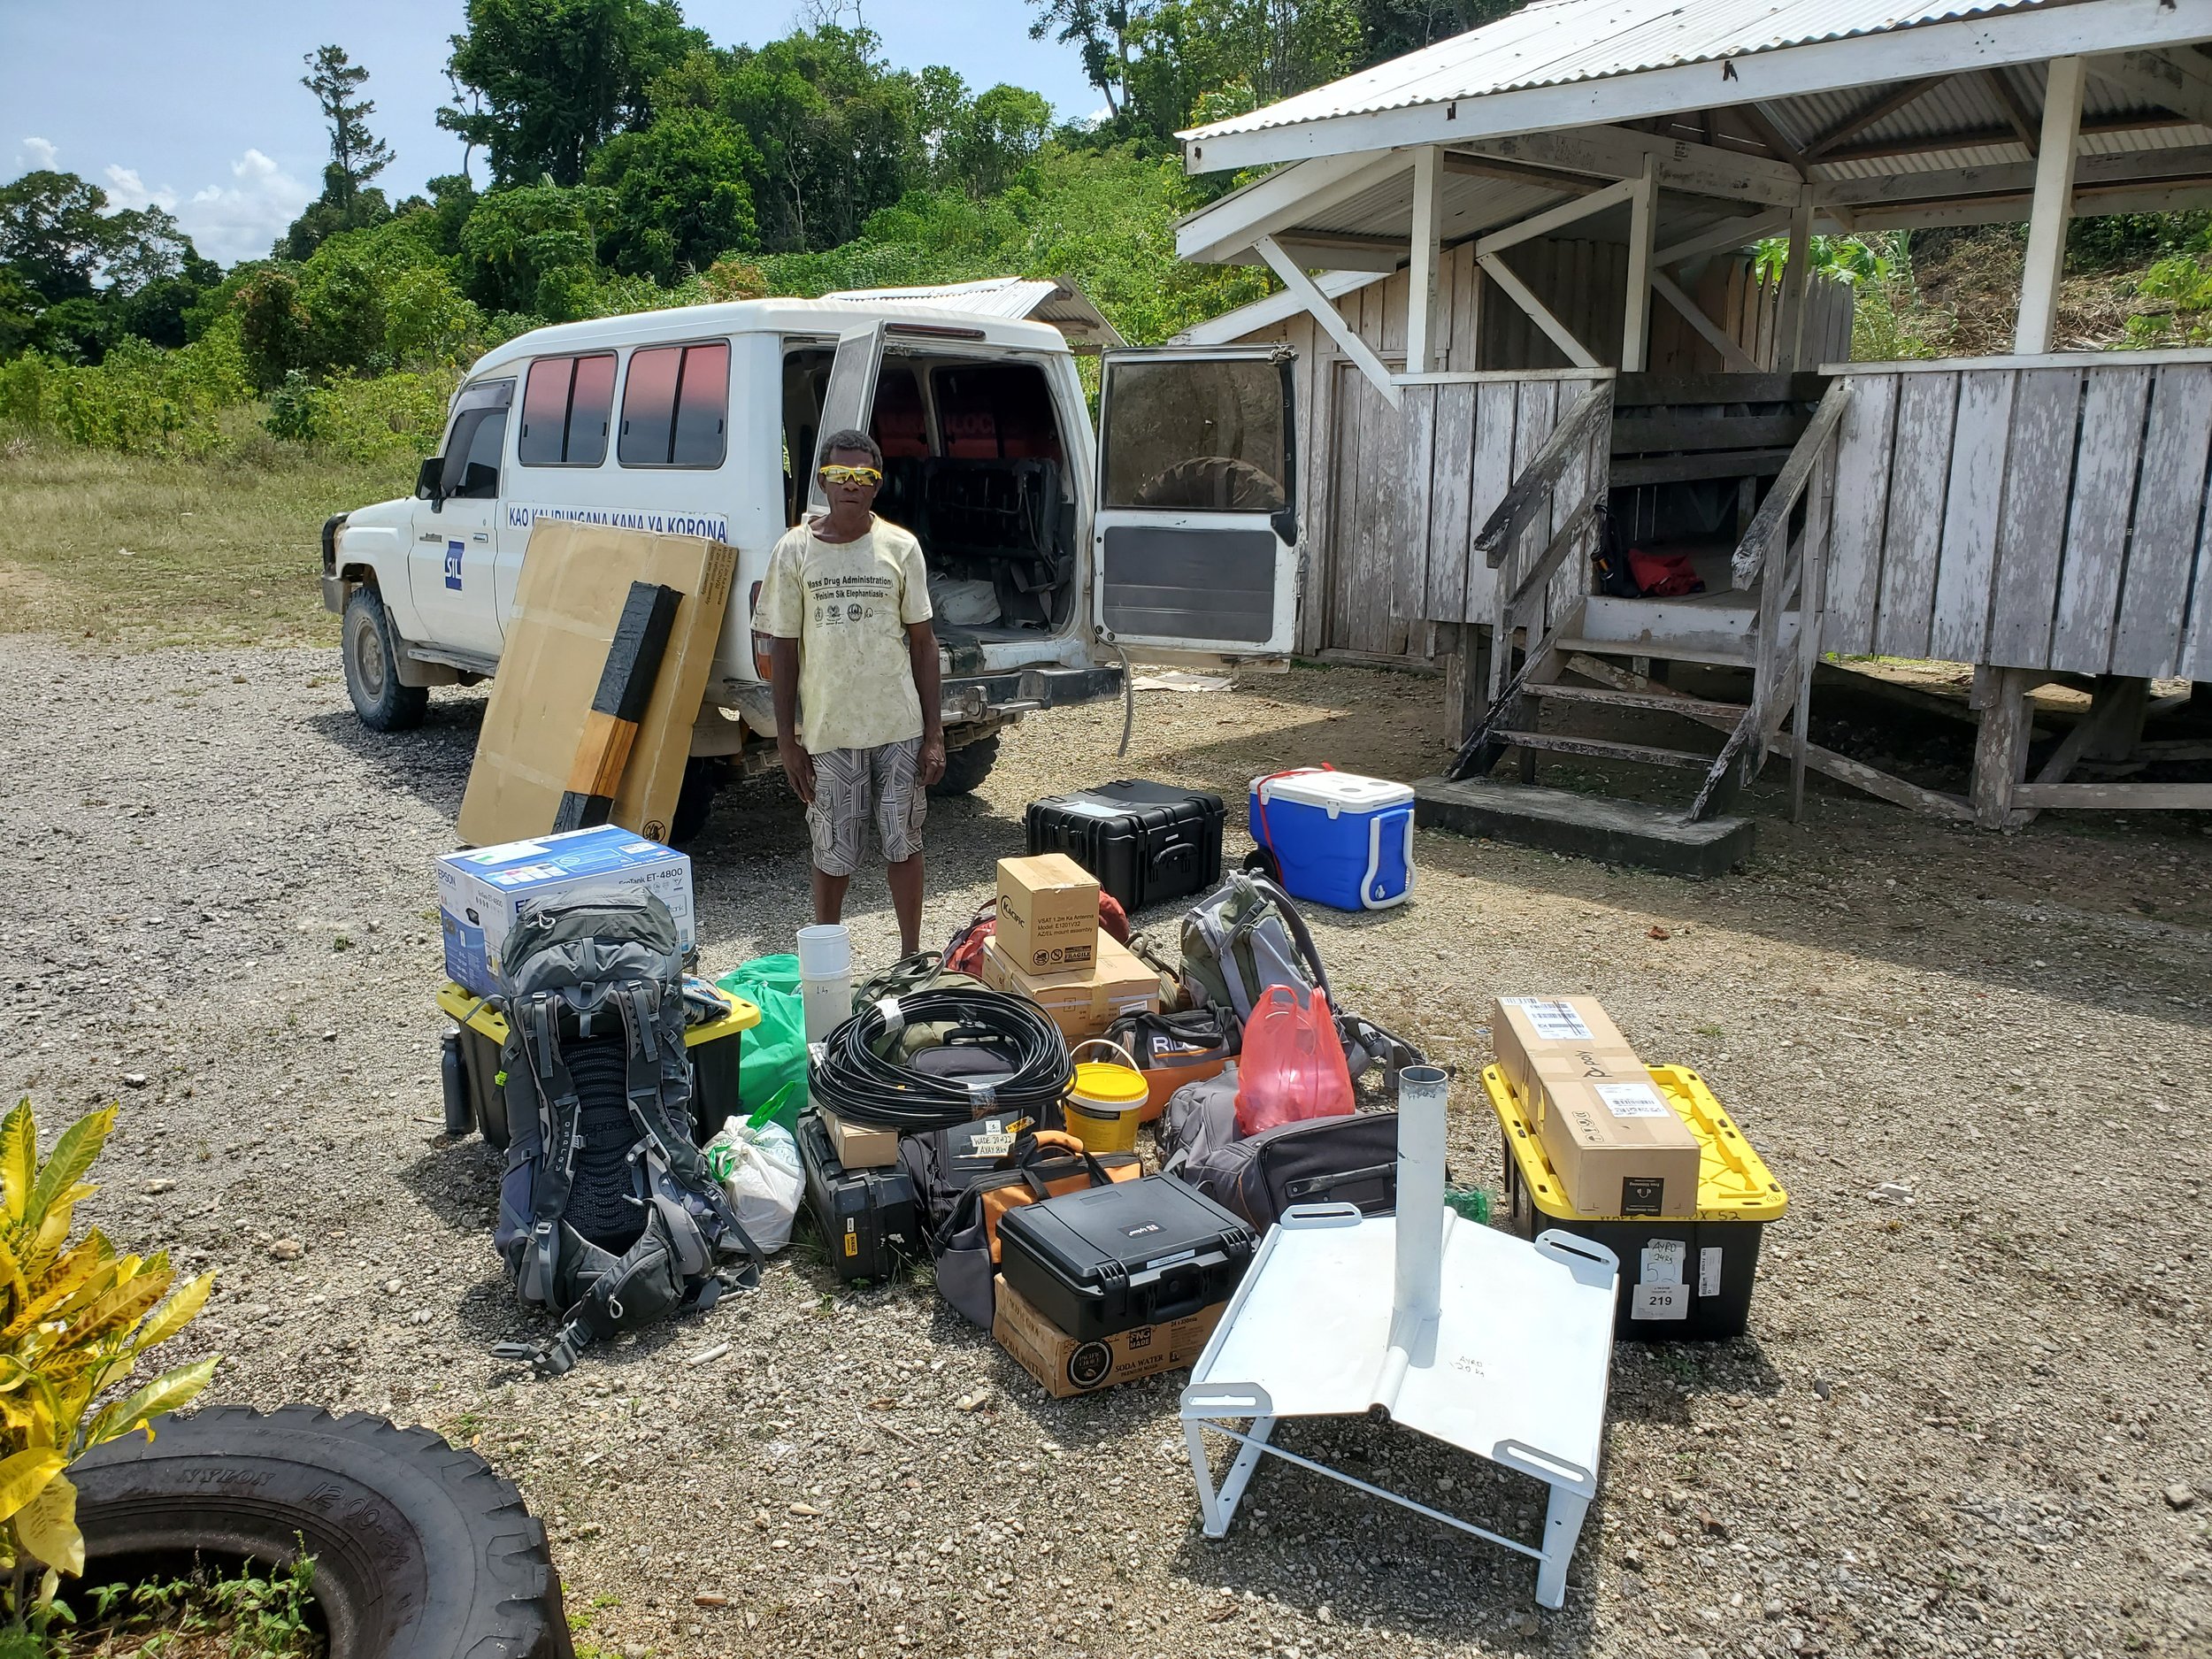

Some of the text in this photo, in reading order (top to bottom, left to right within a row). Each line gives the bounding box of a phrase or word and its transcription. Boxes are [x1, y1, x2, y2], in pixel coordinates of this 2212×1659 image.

[509, 507, 528, 527] KAO
[612, 513, 643, 529] KANA
[667, 517, 726, 543] KORONA
[445, 557, 462, 579] SIL
[824, 577, 841, 587] Drug
[842, 576, 892, 586] Administration
[816, 591, 834, 602] Pinisim
[846, 589, 884, 599] Elephantiasis
[437, 868, 456, 887] EPSON
[647, 867, 684, 883] ET-4800
[1574, 1049, 1601, 1066] poly
[1718, 1210, 1741, 1221] 52
[1649, 1296, 1672, 1306] 219
[1129, 1340, 1150, 1350] MADE
[1115, 1354, 1164, 1373] SODA WATER
[177, 1468, 276, 1486] NYLON
